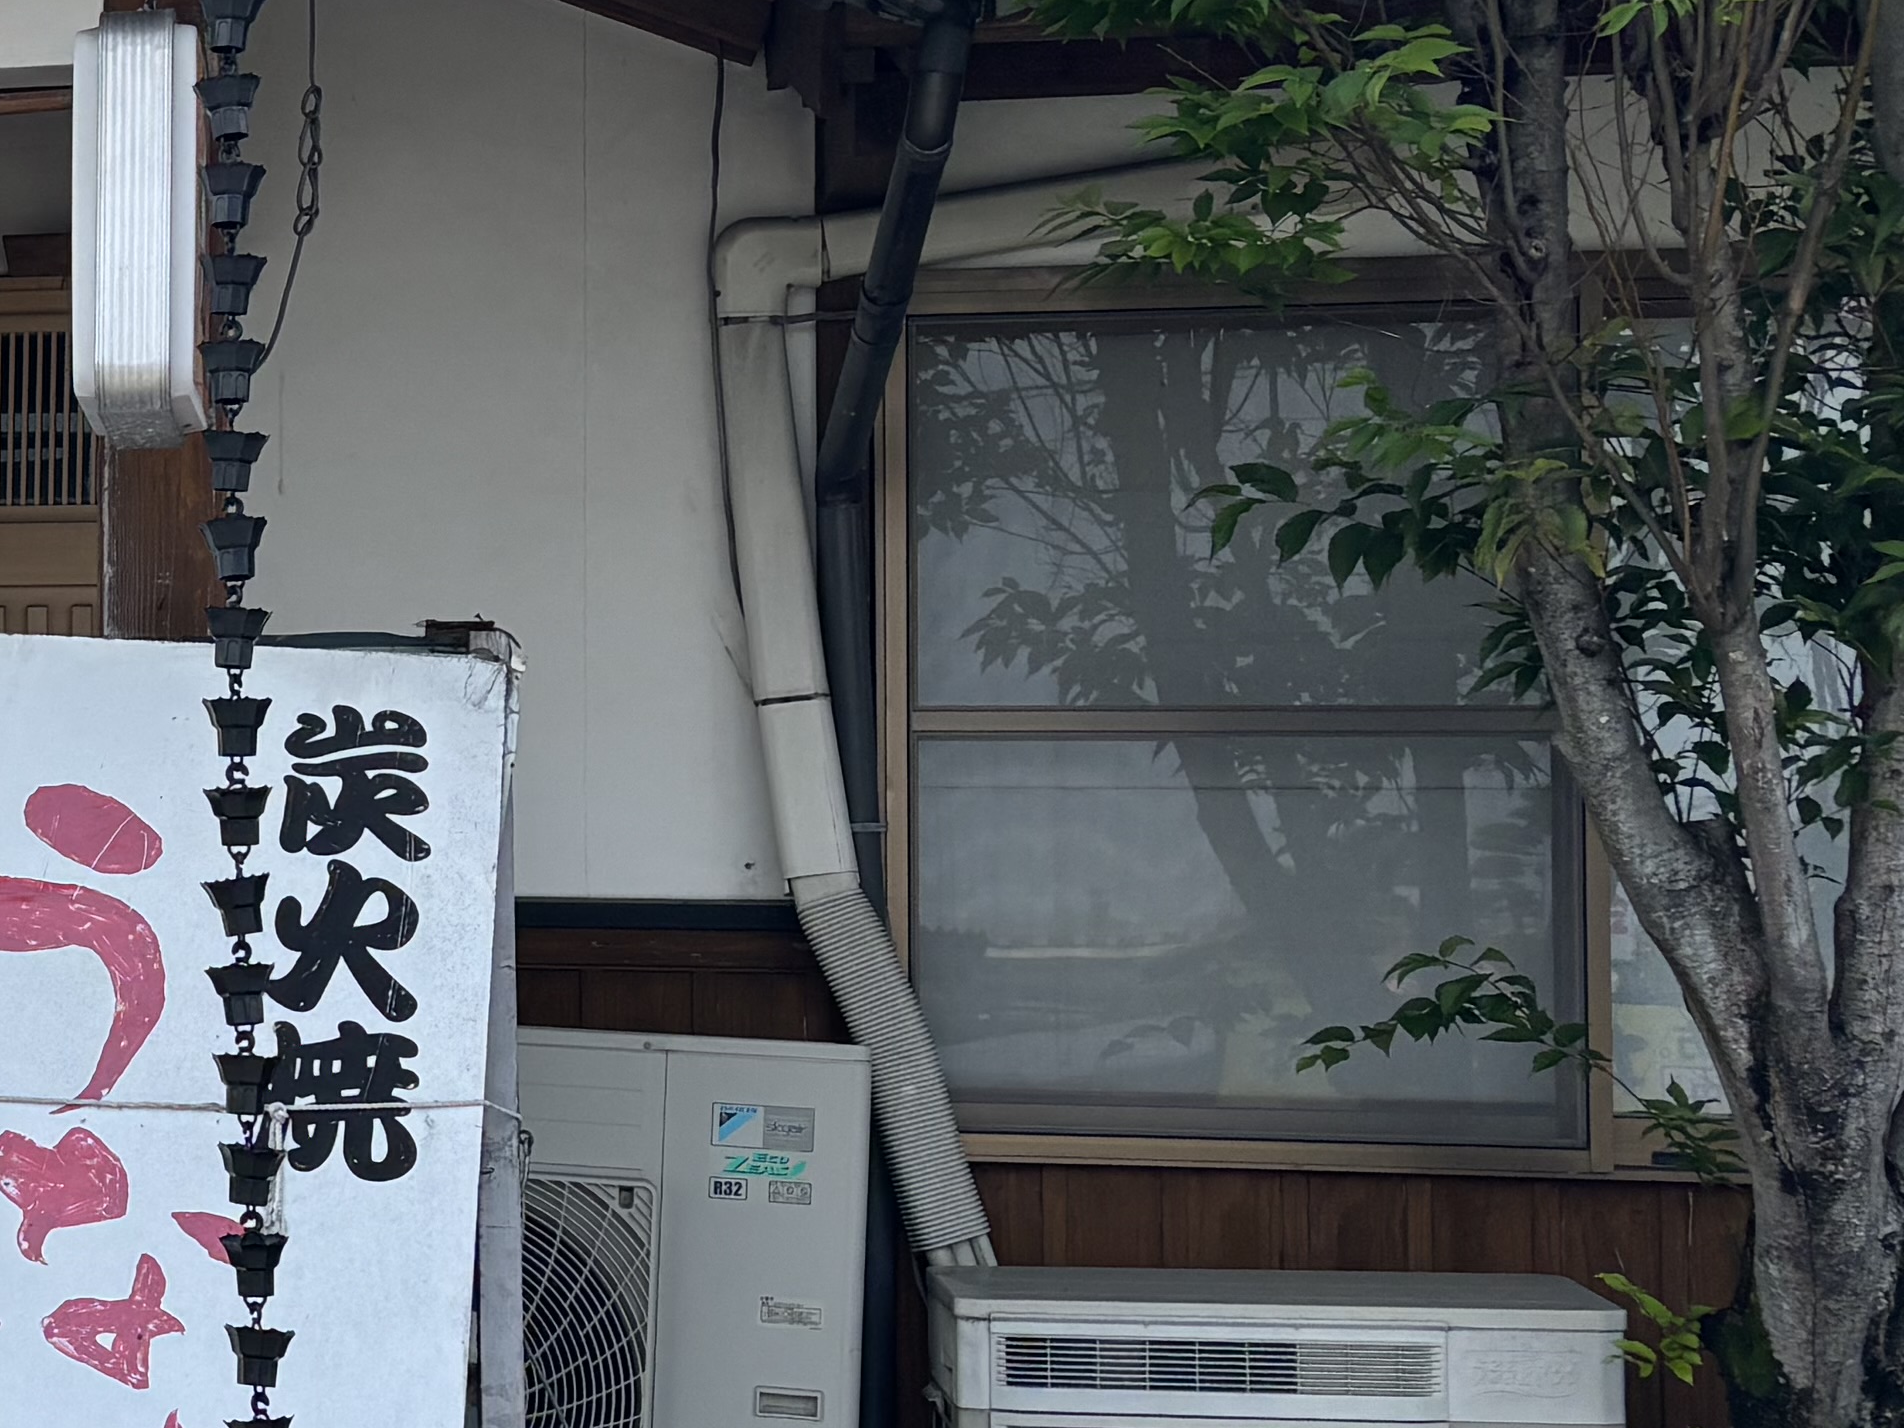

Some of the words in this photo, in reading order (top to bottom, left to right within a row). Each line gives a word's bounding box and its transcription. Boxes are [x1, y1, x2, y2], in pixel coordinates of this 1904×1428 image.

[256, 704, 431, 1182] 炭火焼
[713, 1180, 743, 1197] R32
